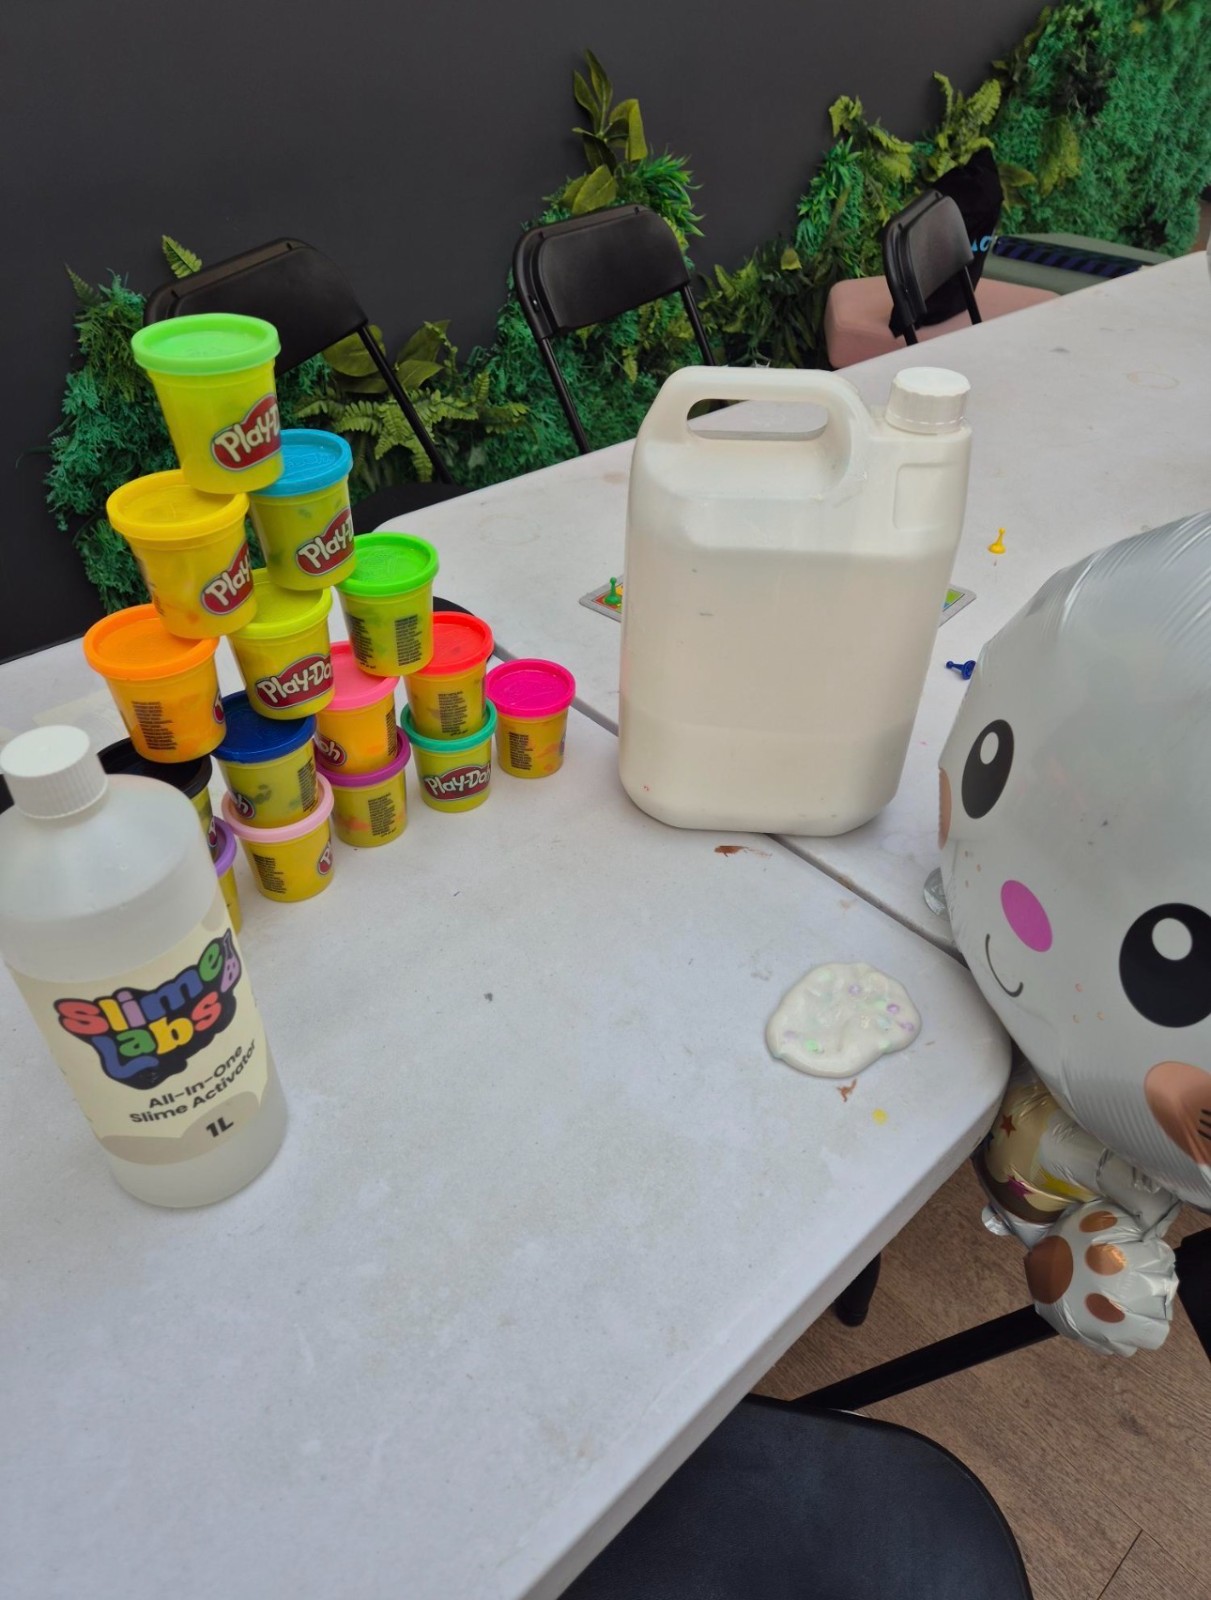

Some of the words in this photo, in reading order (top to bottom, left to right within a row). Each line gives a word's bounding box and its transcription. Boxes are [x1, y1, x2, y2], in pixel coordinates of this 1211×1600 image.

[129, 1104, 189, 1123] Slime
[192, 1038, 256, 1109] Activator
[149, 1046, 243, 1109] All-In-One
[206, 1117, 234, 1138] 1L
